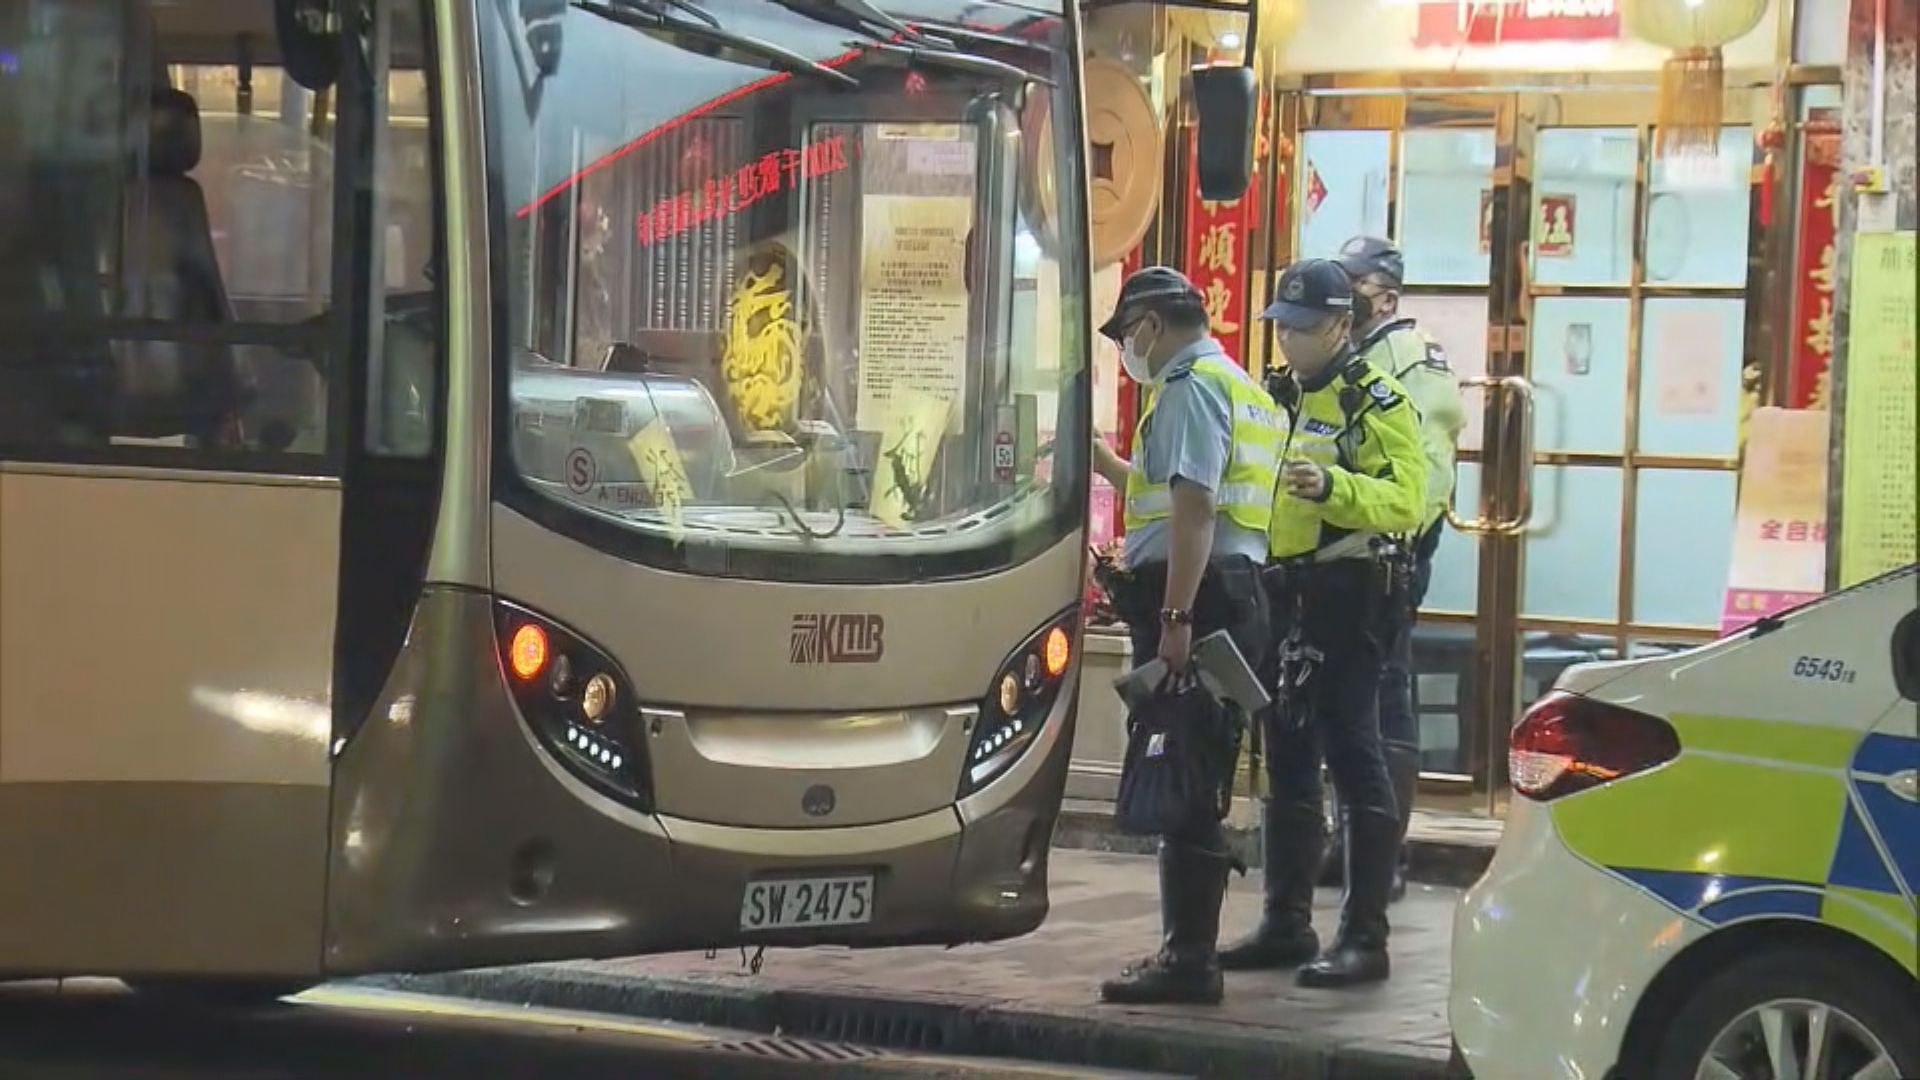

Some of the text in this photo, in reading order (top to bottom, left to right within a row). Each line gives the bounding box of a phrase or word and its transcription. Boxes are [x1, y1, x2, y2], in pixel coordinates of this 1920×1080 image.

[572, 455, 589, 486] S
[817, 614, 884, 663] KMB
[1793, 656, 1844, 681] 6543
[749, 881, 866, 926] SW 2475
